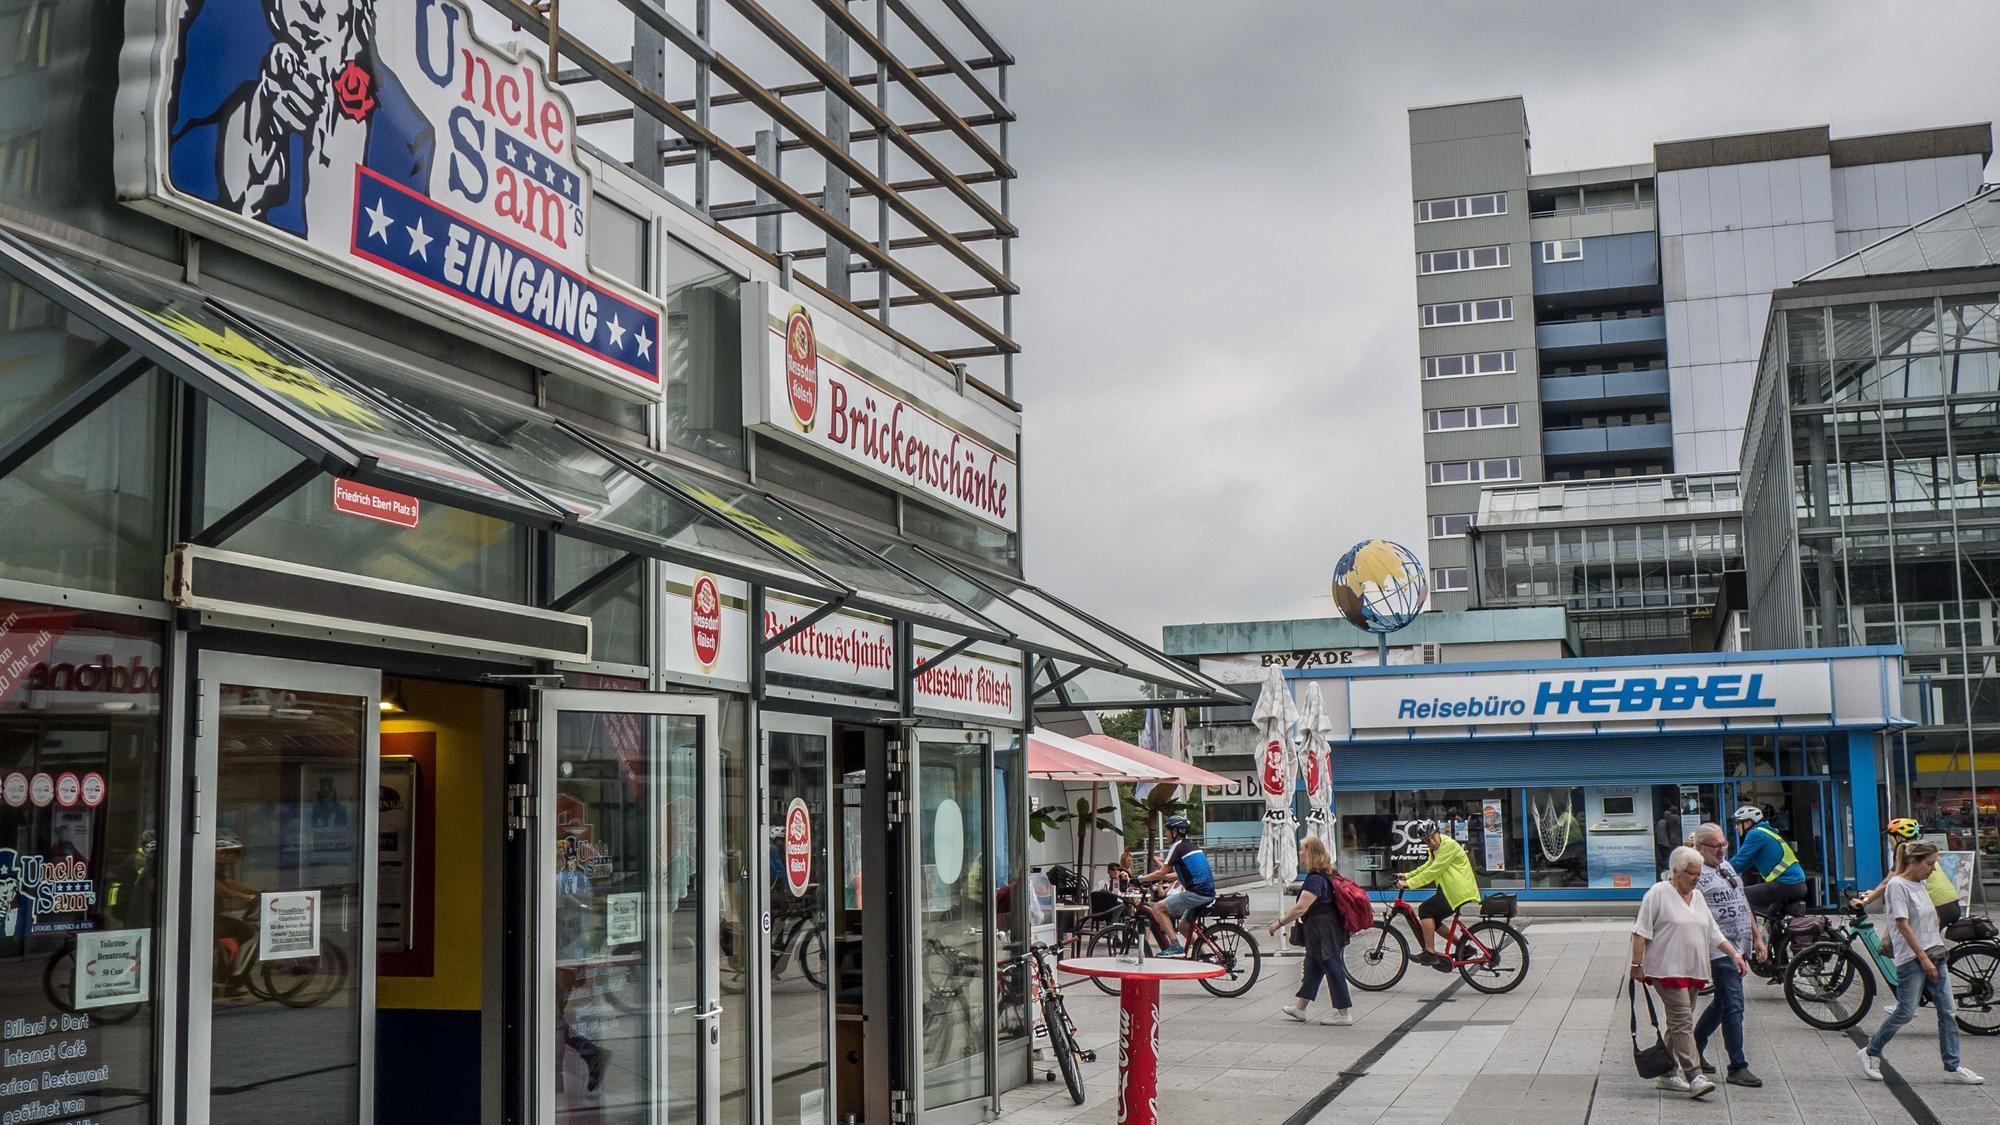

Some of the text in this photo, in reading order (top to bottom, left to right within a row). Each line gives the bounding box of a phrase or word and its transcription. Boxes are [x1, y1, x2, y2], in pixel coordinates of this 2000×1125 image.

[415, 0, 564, 154] Uncle
[448, 104, 584, 250] Sam's
[443, 223, 599, 344] EINGANG
[827, 377, 1008, 519] Brückenschänke
[337, 486, 417, 517] Friedrich Ebert Platz 9
[8, 656, 29, 679] Uhr
[1398, 672, 1777, 720] Reisebüro HEBBEL
[21, 855, 87, 888] Uncle
[36, 881, 97, 914] Sam's
[4, 1015, 47, 1039] Billard
[61, 1013, 89, 1032] Dart
[4, 1039, 87, 1068] Internet Café
[41, 1064, 109, 1090] Restaurant
[61, 1098, 86, 1114] von
